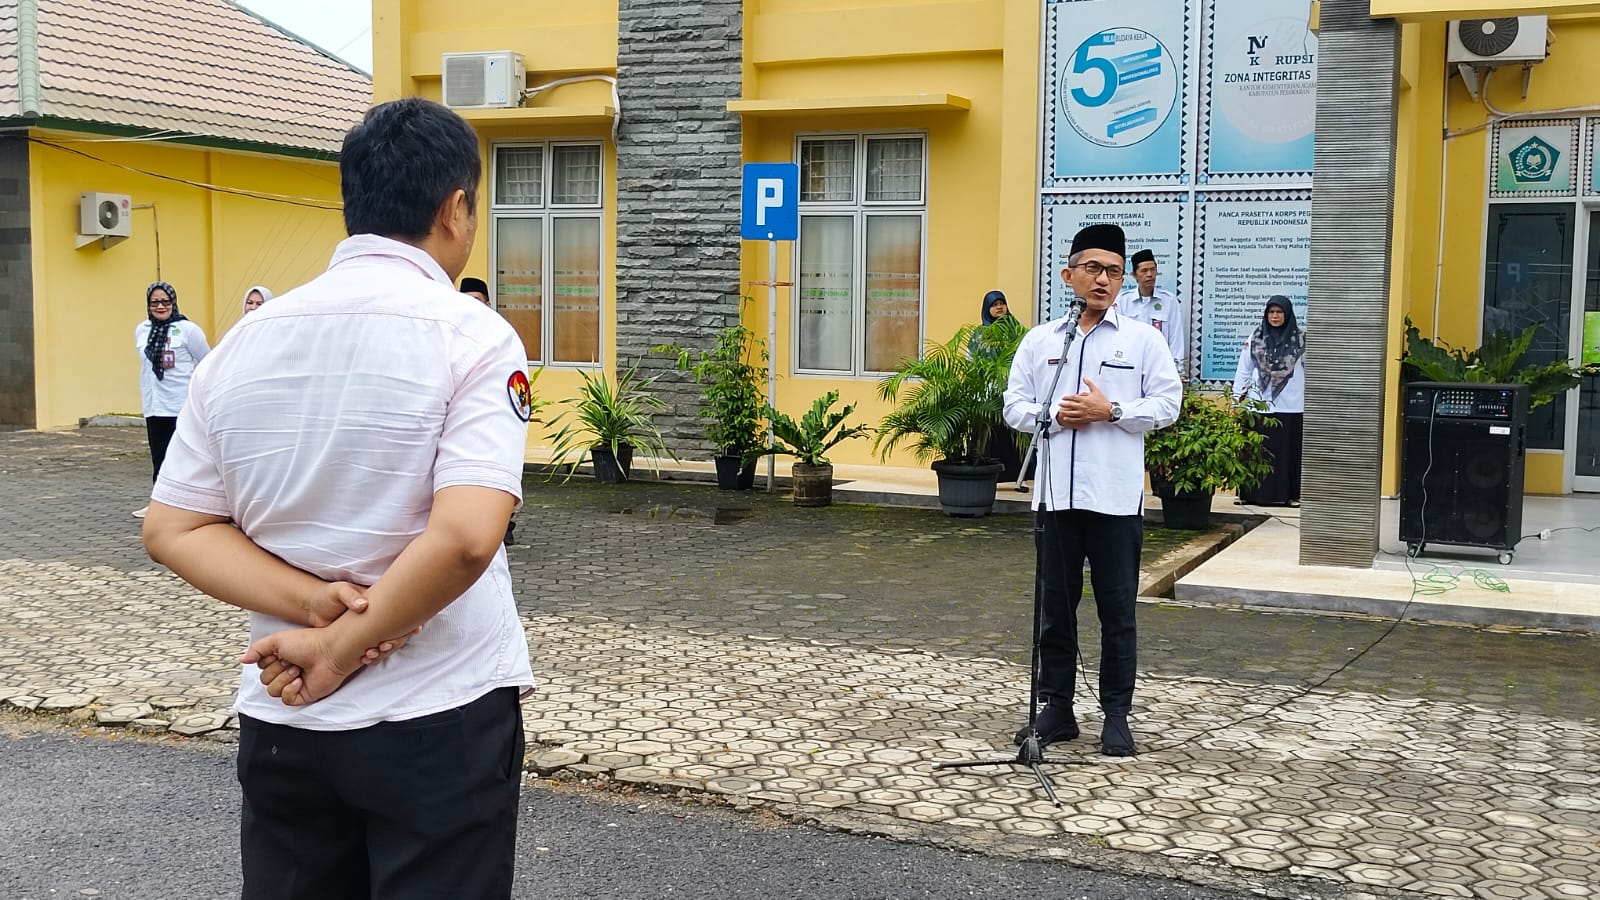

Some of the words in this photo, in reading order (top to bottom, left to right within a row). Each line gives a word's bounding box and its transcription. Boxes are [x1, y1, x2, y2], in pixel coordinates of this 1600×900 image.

[1071, 32, 1118, 107] 5
[1224, 73, 1250, 83] ZONA
[1252, 70, 1311, 82] INTEGRITAS
[756, 178, 784, 226] P
